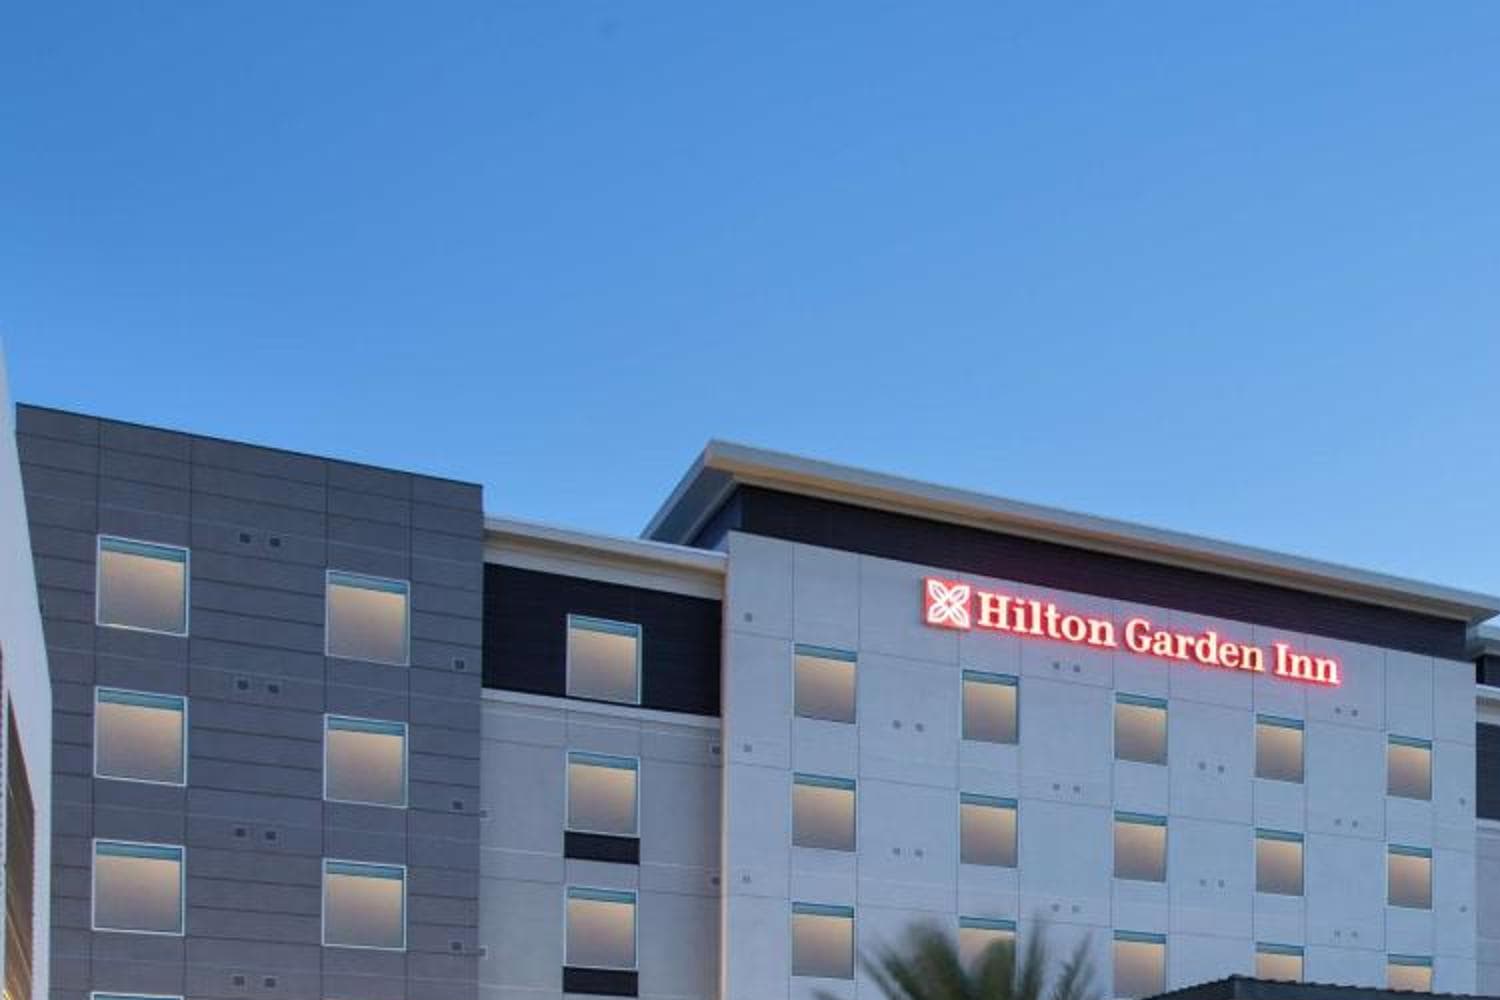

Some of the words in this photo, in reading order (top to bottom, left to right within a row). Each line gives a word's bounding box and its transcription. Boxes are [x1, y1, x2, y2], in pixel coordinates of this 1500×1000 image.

[977, 591, 1116, 648] Hilton
[1125, 618, 1265, 672] Garden
[1274, 643, 1340, 685] Inn
